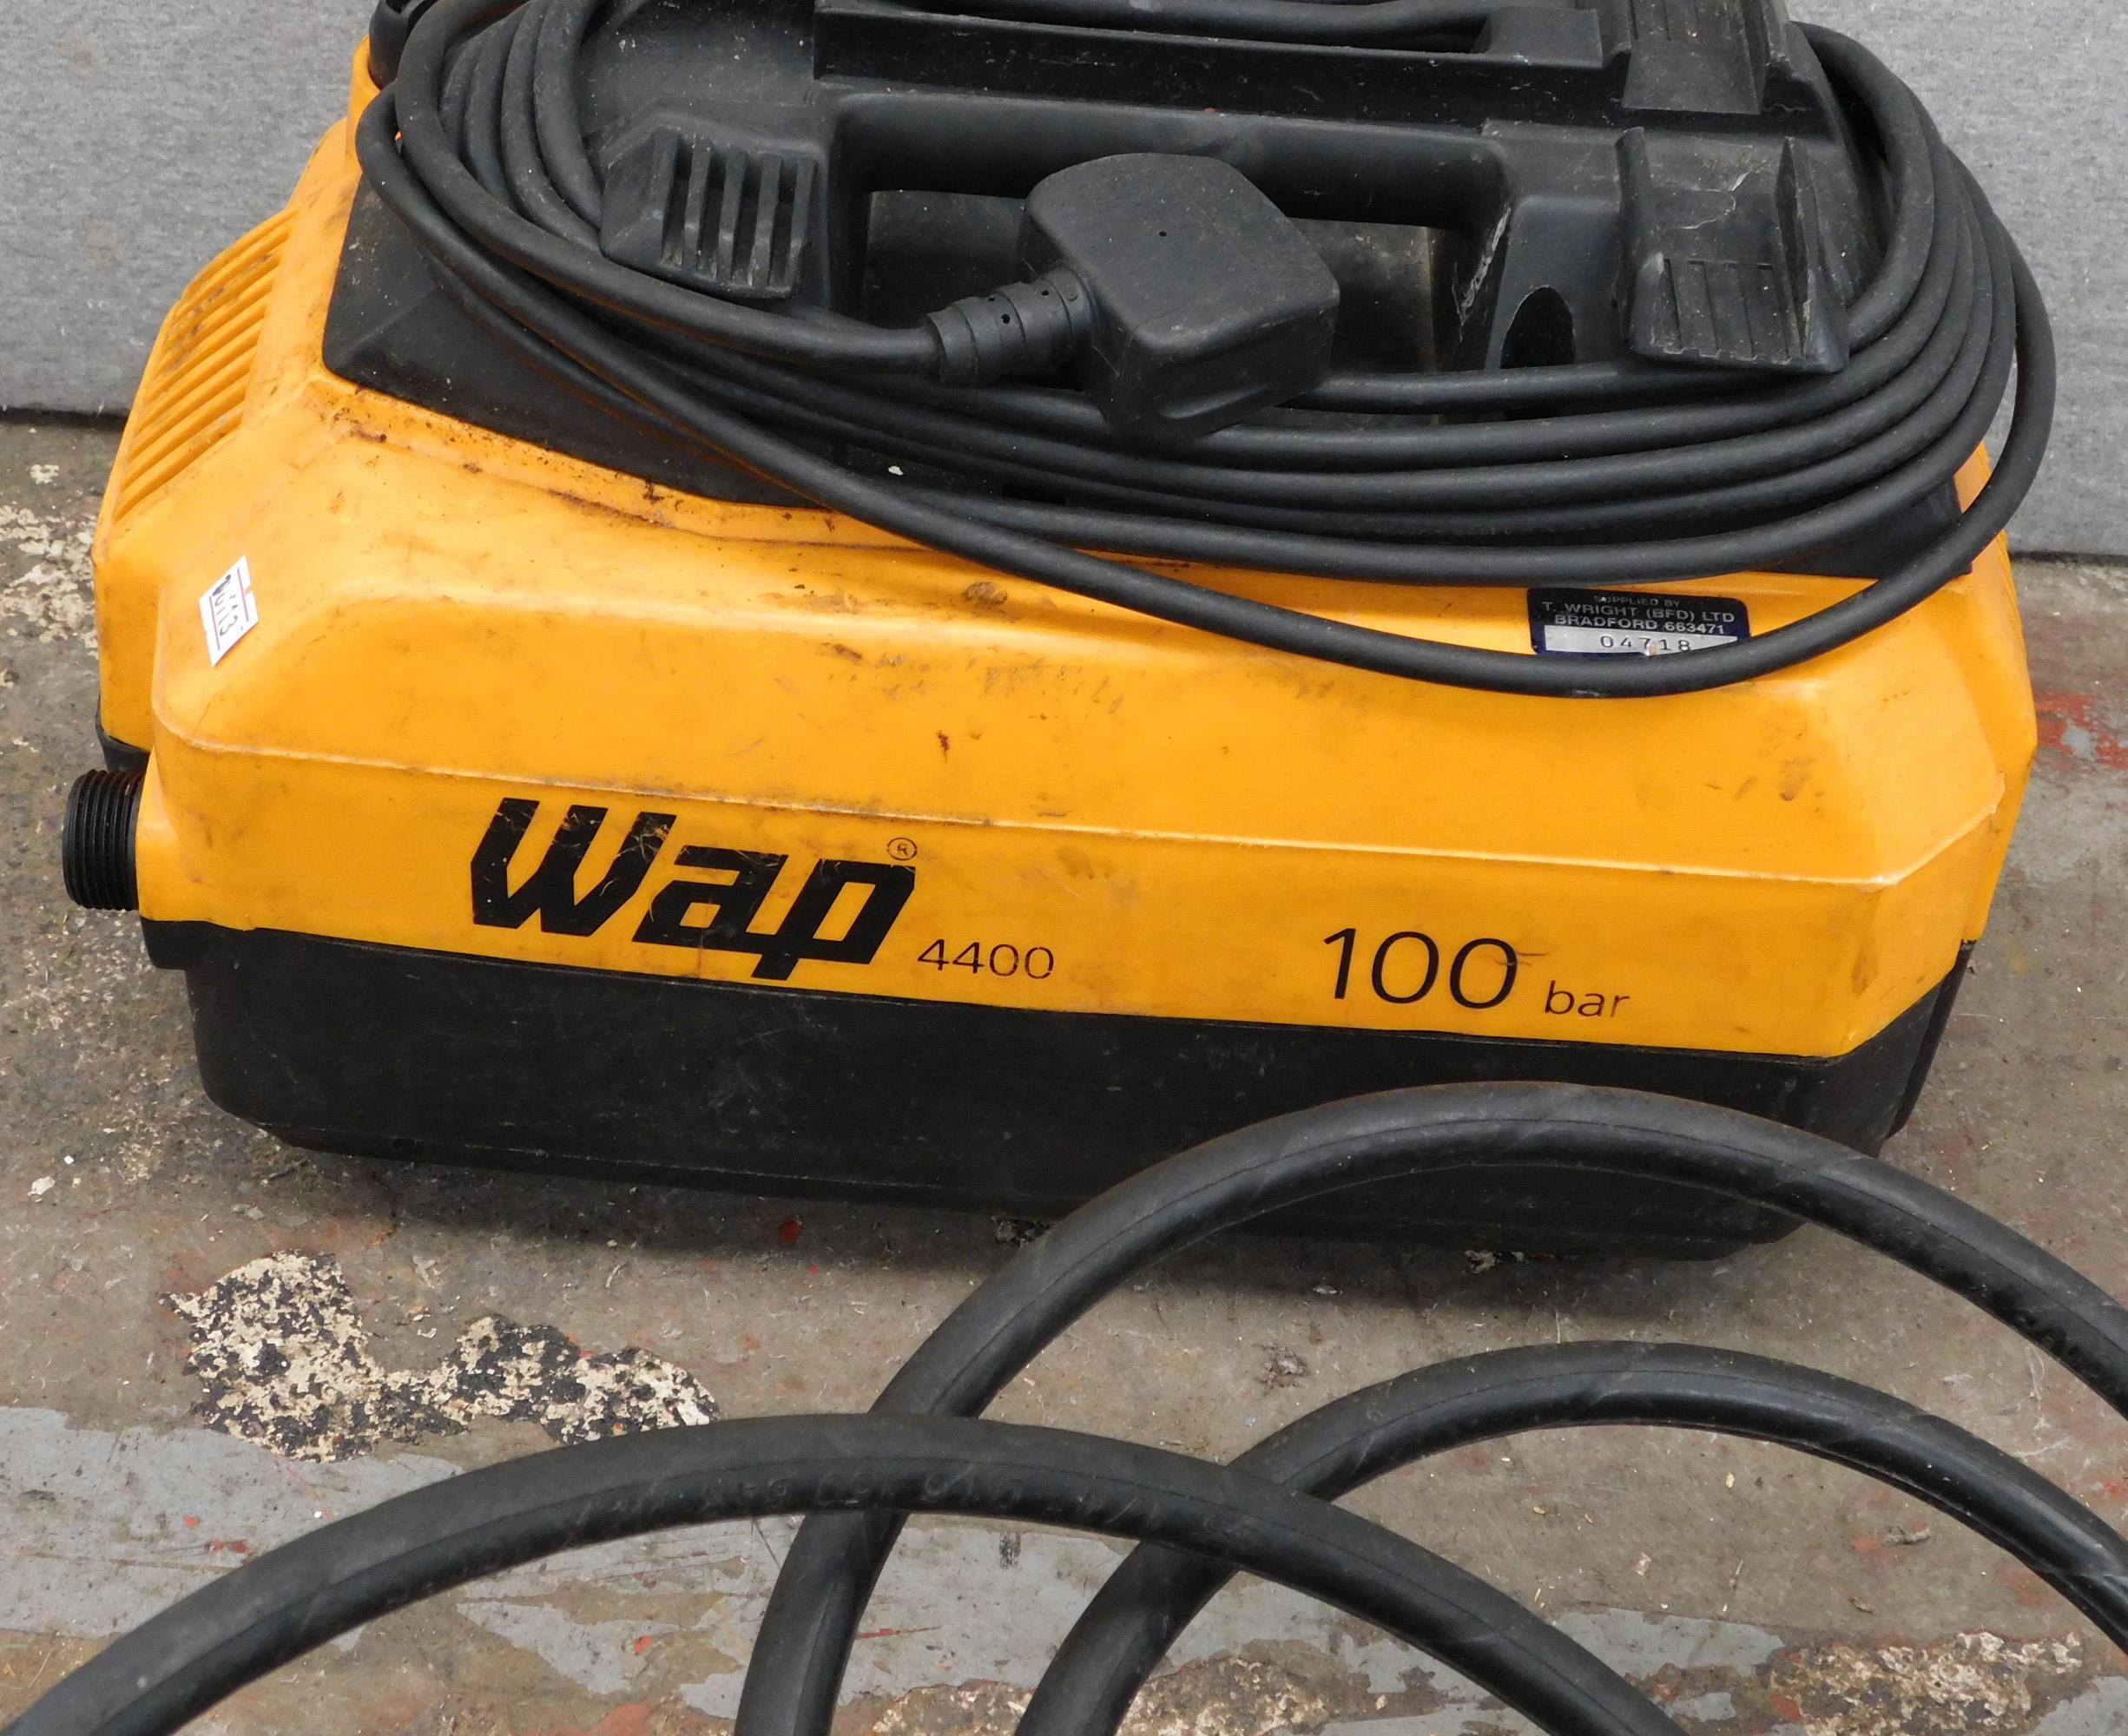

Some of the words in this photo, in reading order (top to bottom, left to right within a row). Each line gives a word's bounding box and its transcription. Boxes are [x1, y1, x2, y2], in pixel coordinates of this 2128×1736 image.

[1542, 601, 1557, 613] T.
[1564, 602, 1638, 617] WRIGHT
[1646, 608, 1696, 622] (BFD)
[1702, 610, 1736, 623] LTD
[1593, 595, 1659, 606] SUPPLIED
[1664, 599, 1681, 608] BY
[1554, 614, 1658, 630] BRADFORD
[1664, 621, 1725, 635] 663471
[1599, 635, 1692, 652] 04718
[470, 797, 916, 981] Wap
[917, 938, 1055, 980] 4400
[1322, 927, 1519, 1009] 100
[1544, 979, 1631, 1018] bar
